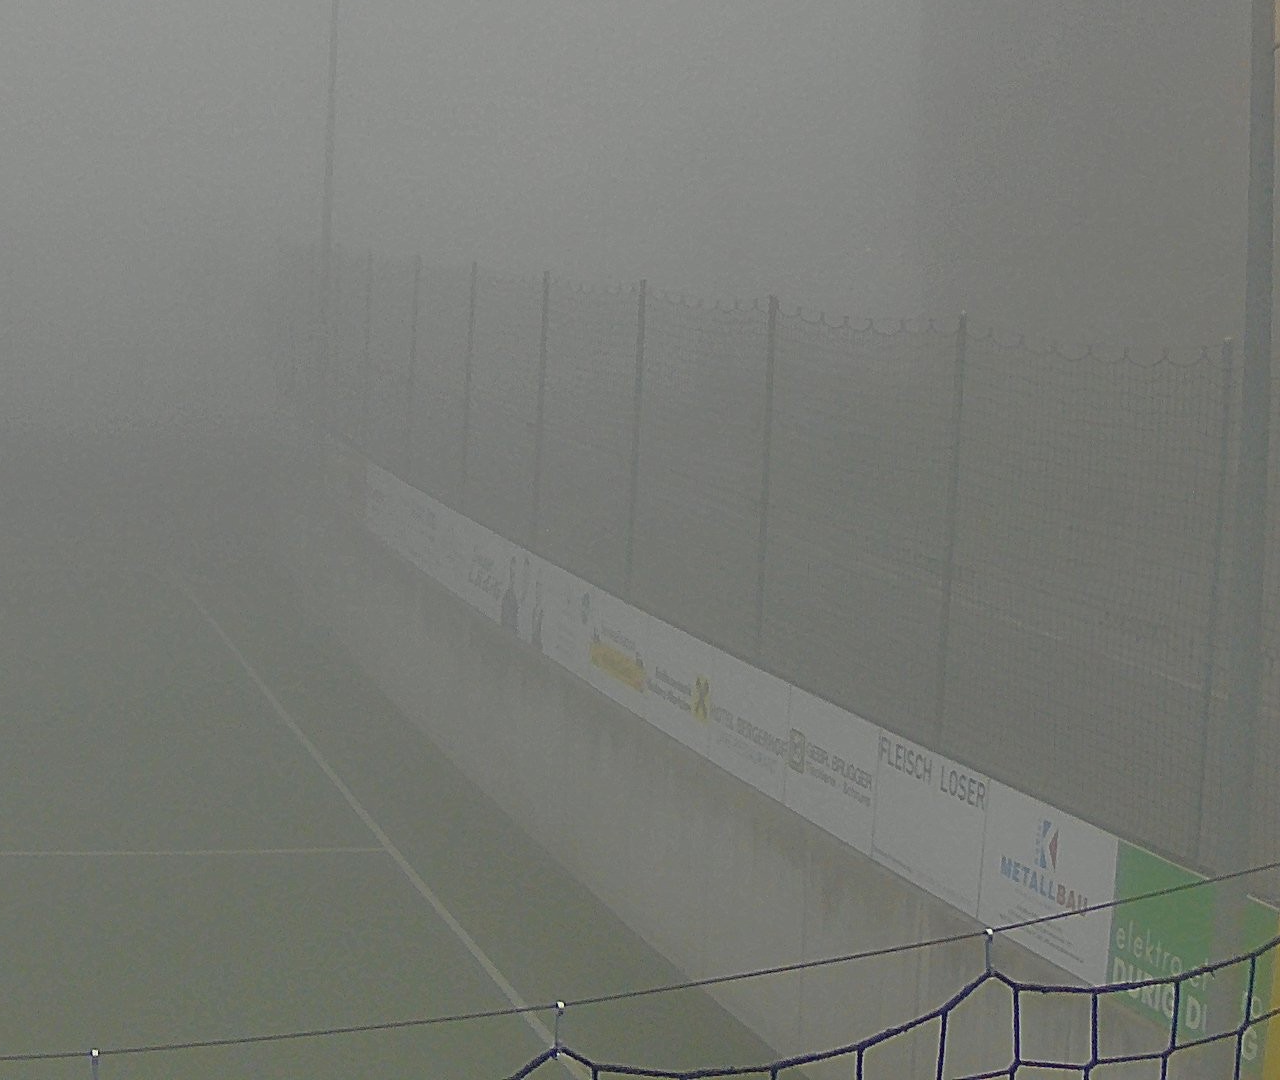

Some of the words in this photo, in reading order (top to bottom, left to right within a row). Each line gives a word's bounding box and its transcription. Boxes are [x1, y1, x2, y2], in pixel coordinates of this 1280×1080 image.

[879, 736, 933, 785] FLEISCH
[940, 765, 986, 810] LOSER
[1000, 854, 1088, 917] METALLBAU
[1116, 919, 1182, 976] elektro
